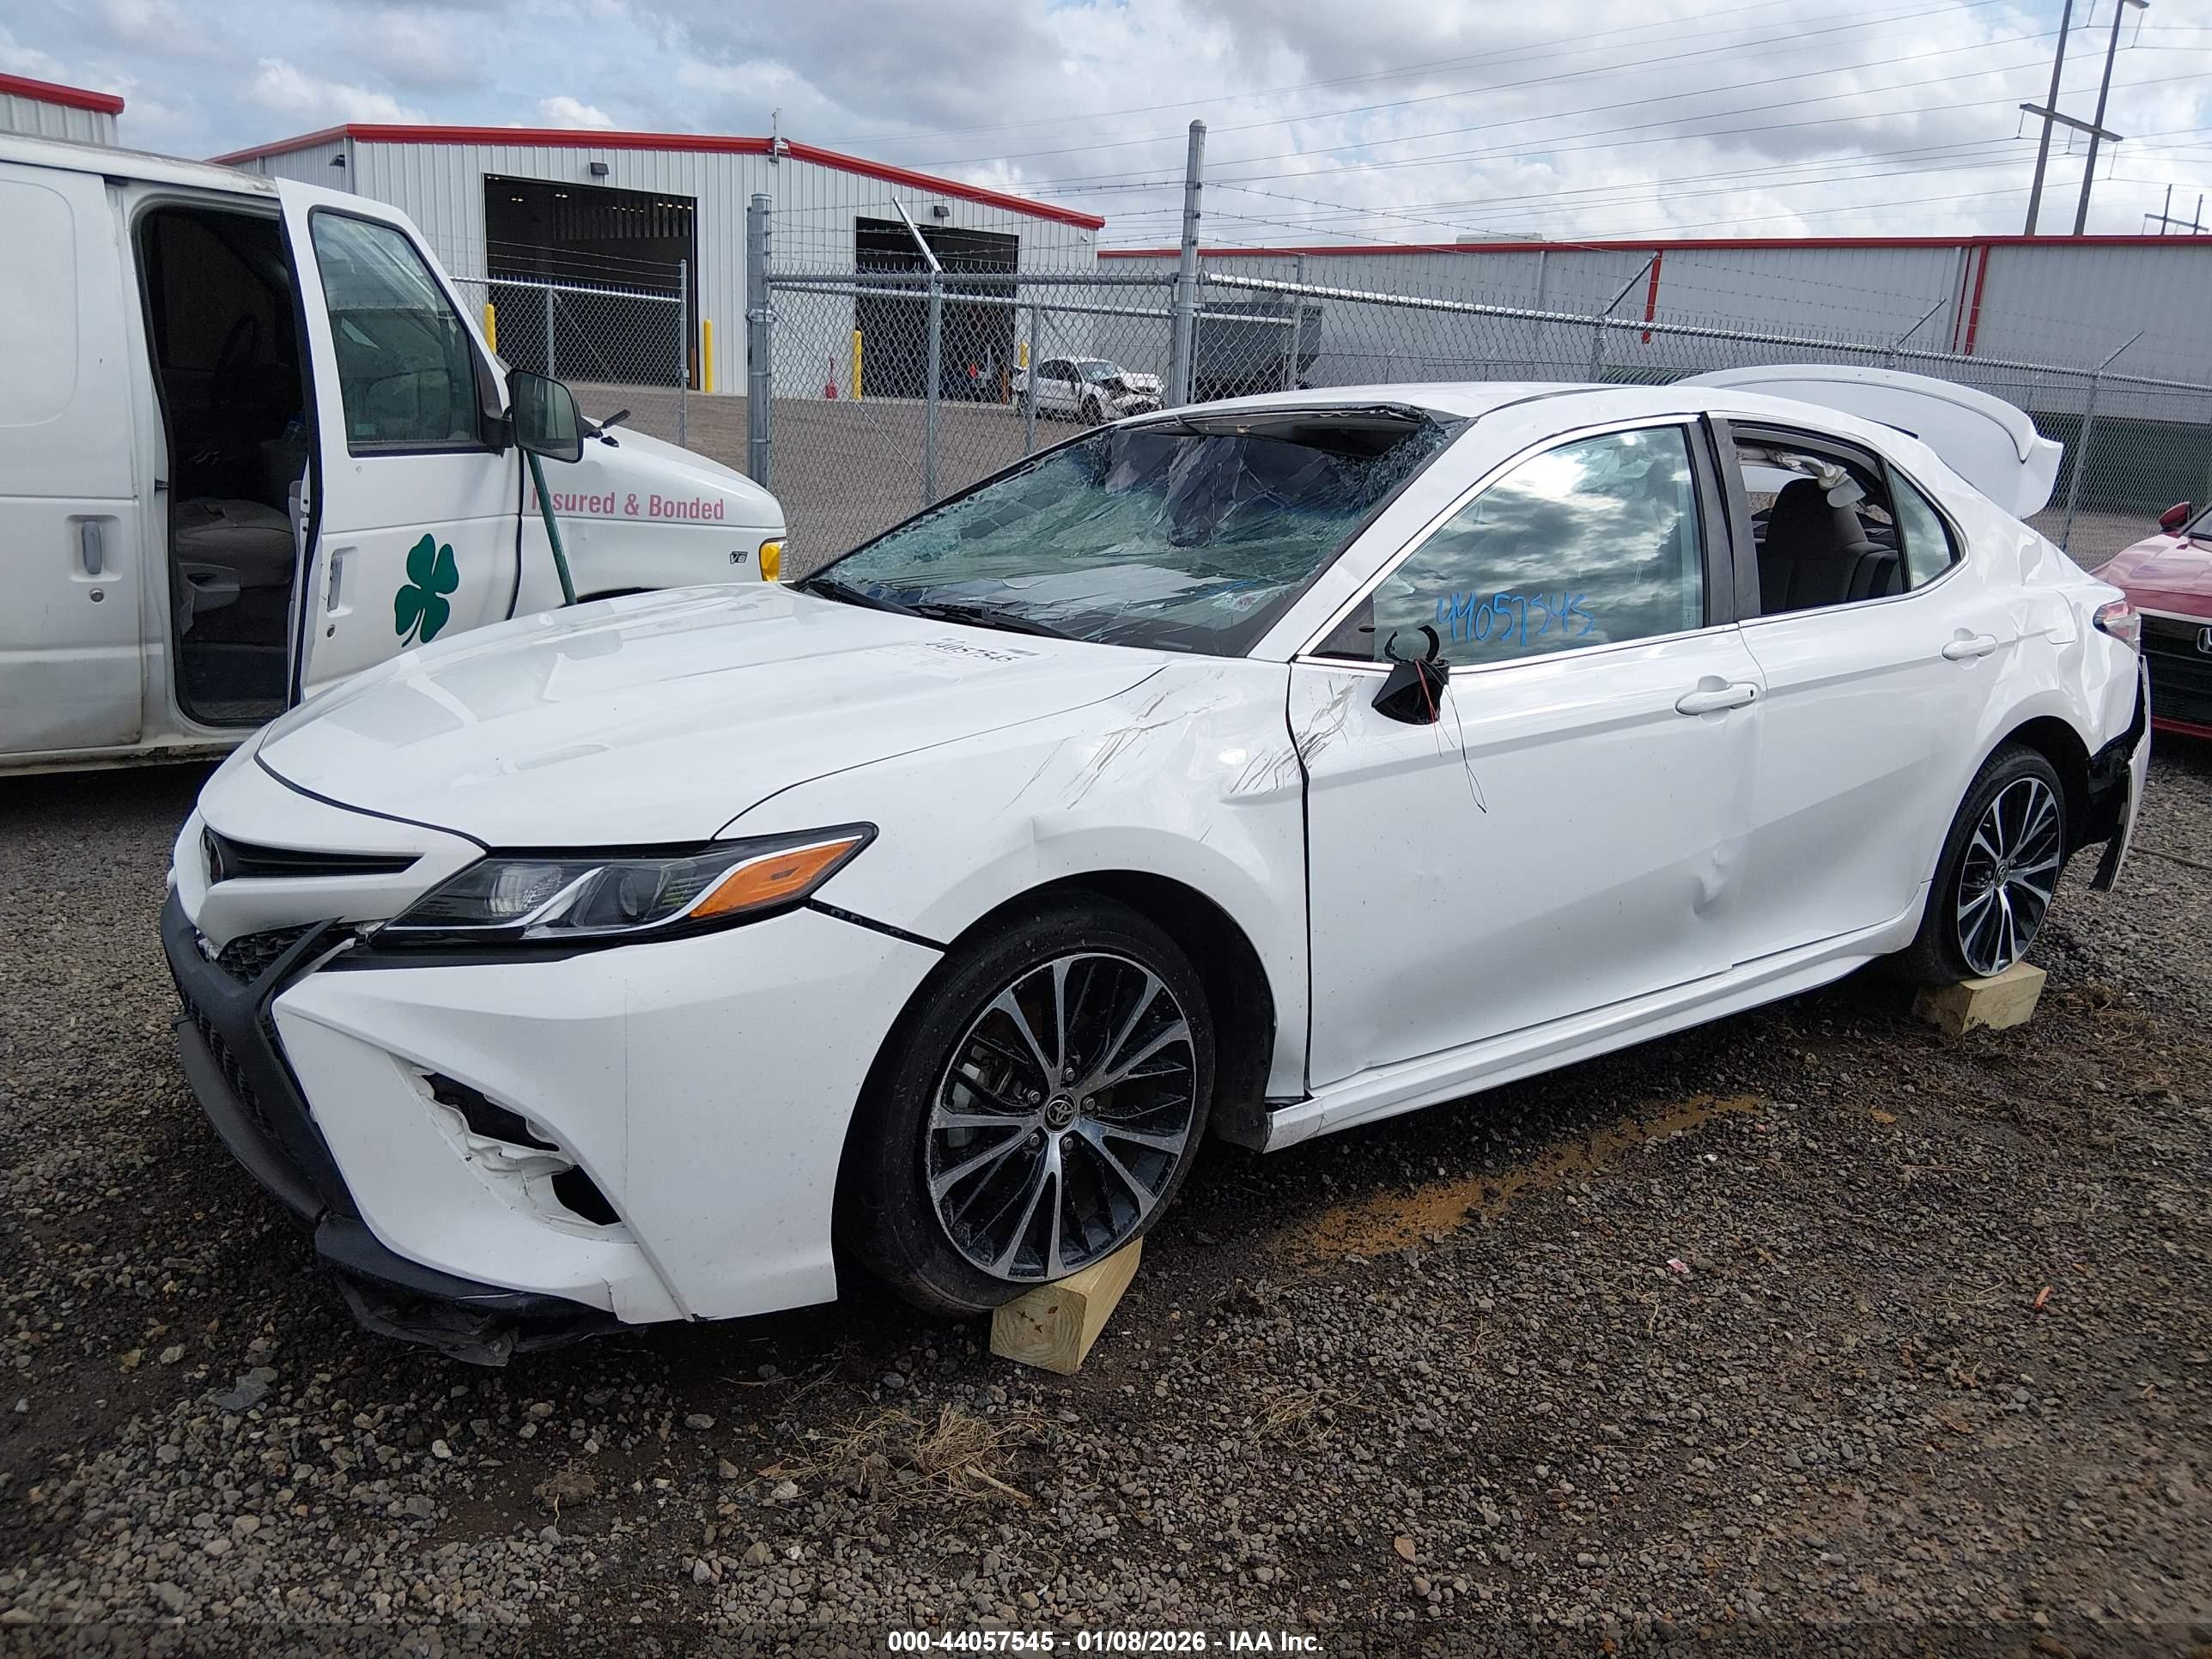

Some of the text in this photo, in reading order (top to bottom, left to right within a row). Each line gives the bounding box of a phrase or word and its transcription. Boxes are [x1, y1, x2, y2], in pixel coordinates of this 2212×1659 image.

[532, 487, 725, 520] Isured & Bonded
[1437, 591, 1595, 646] 44057545
